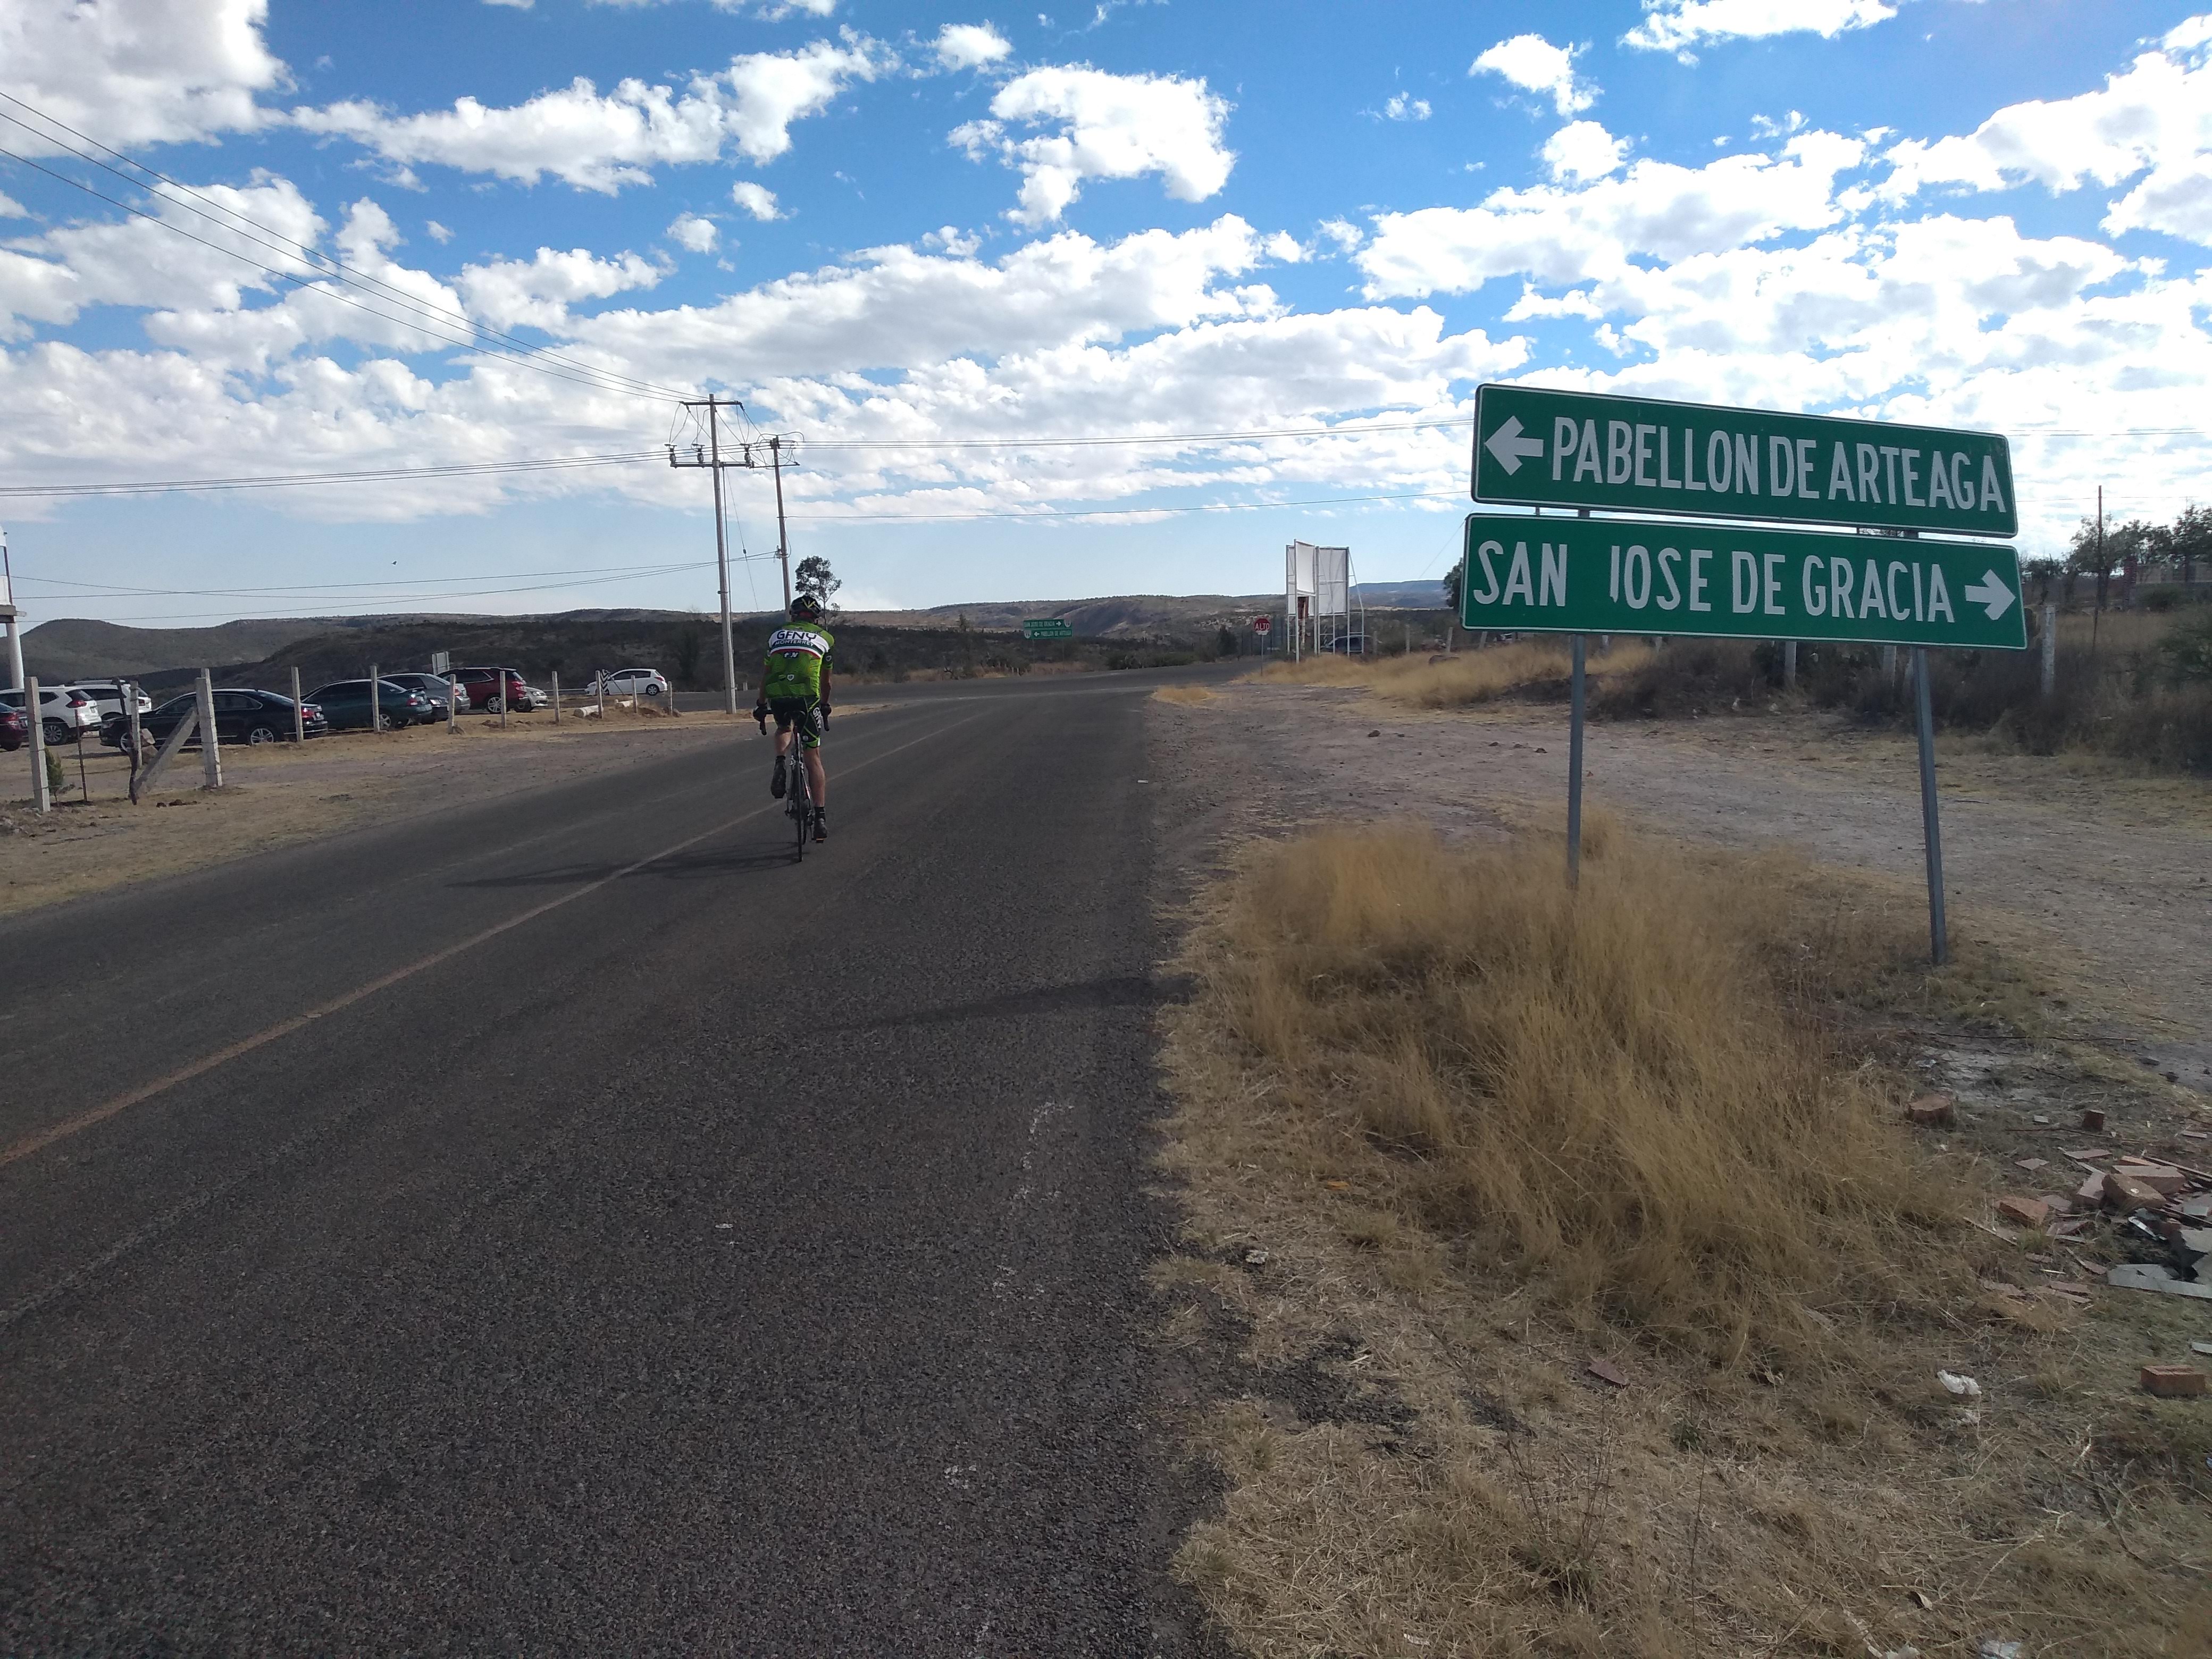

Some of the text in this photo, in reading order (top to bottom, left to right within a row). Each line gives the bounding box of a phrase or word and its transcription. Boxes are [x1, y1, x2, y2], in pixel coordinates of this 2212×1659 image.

[1553, 416, 2007, 513] PABELLON DE ARTEAGA
[1473, 540, 1568, 607] SAN
[1731, 550, 1786, 615] DE
[1802, 555, 1955, 623] GRACIA
[776, 630, 817, 641] GFNY
